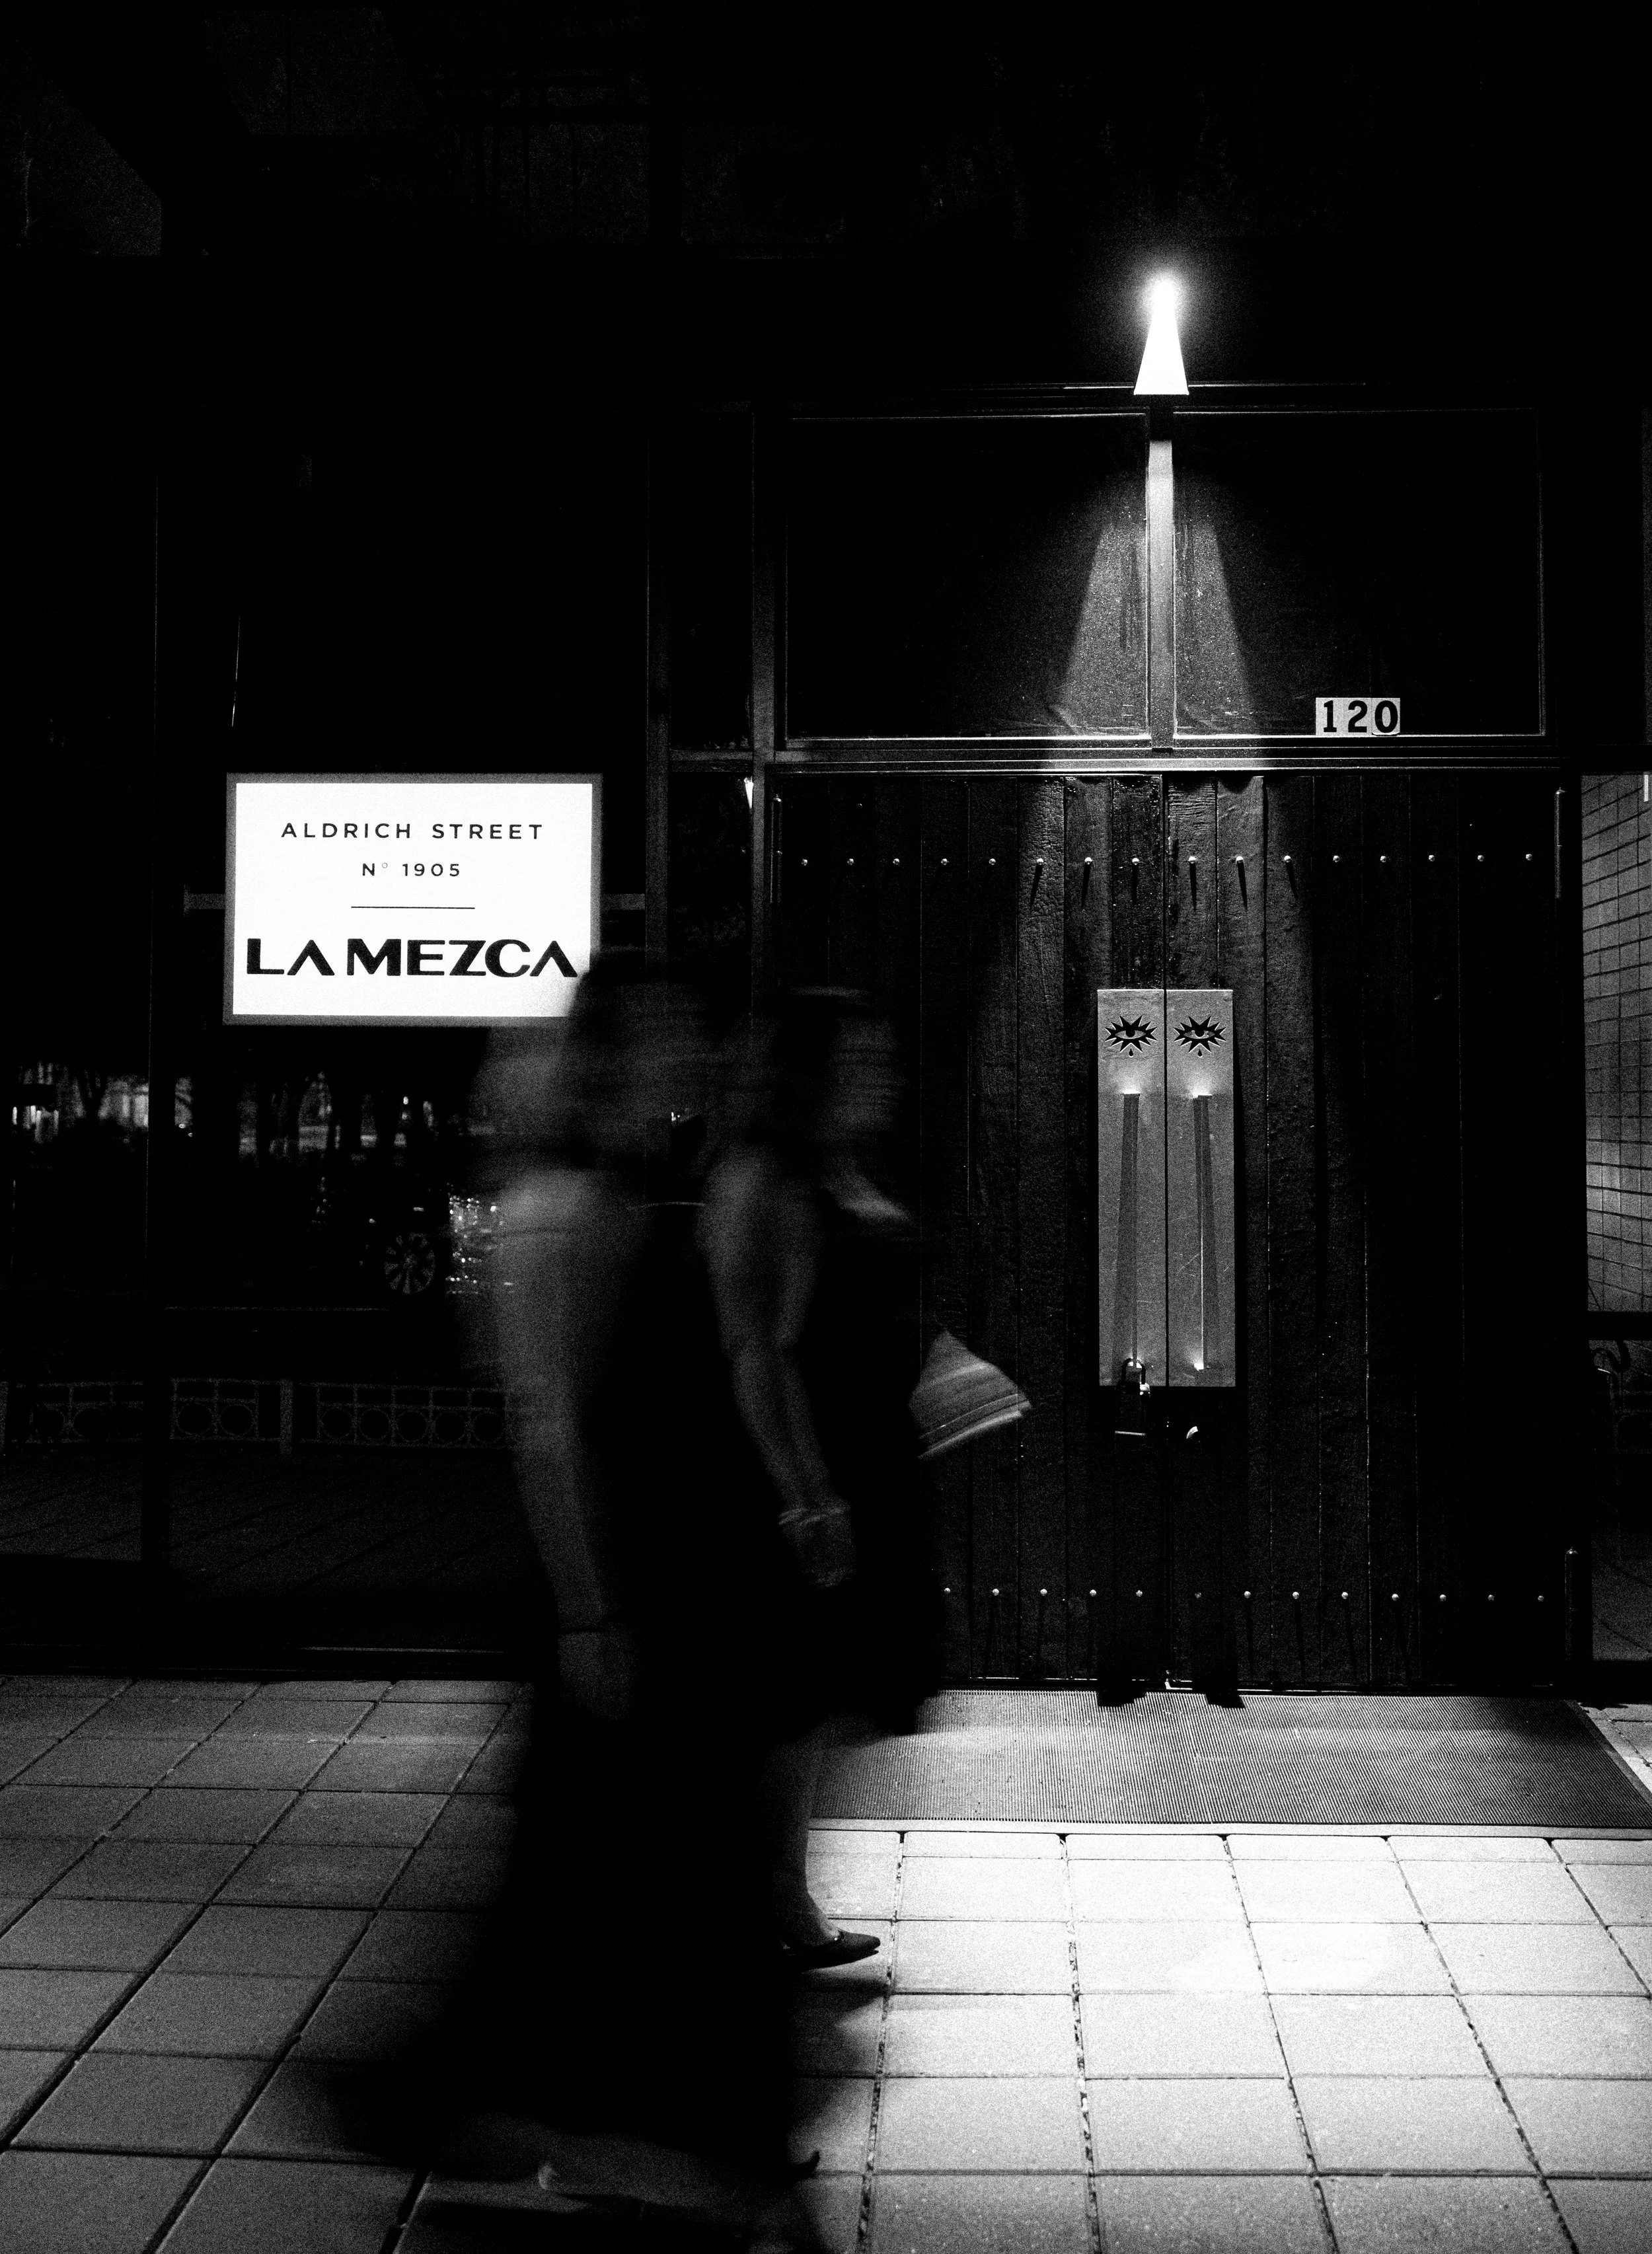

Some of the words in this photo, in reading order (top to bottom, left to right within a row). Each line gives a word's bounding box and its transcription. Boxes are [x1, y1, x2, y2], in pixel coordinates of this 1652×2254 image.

[1324, 700, 1398, 733] 120
[281, 823, 411, 839] ALDRICH
[432, 823, 543, 840] STREET
[402, 863, 461, 878] 1905
[246, 938, 335, 976] LA
[346, 938, 578, 977] MEZCA
